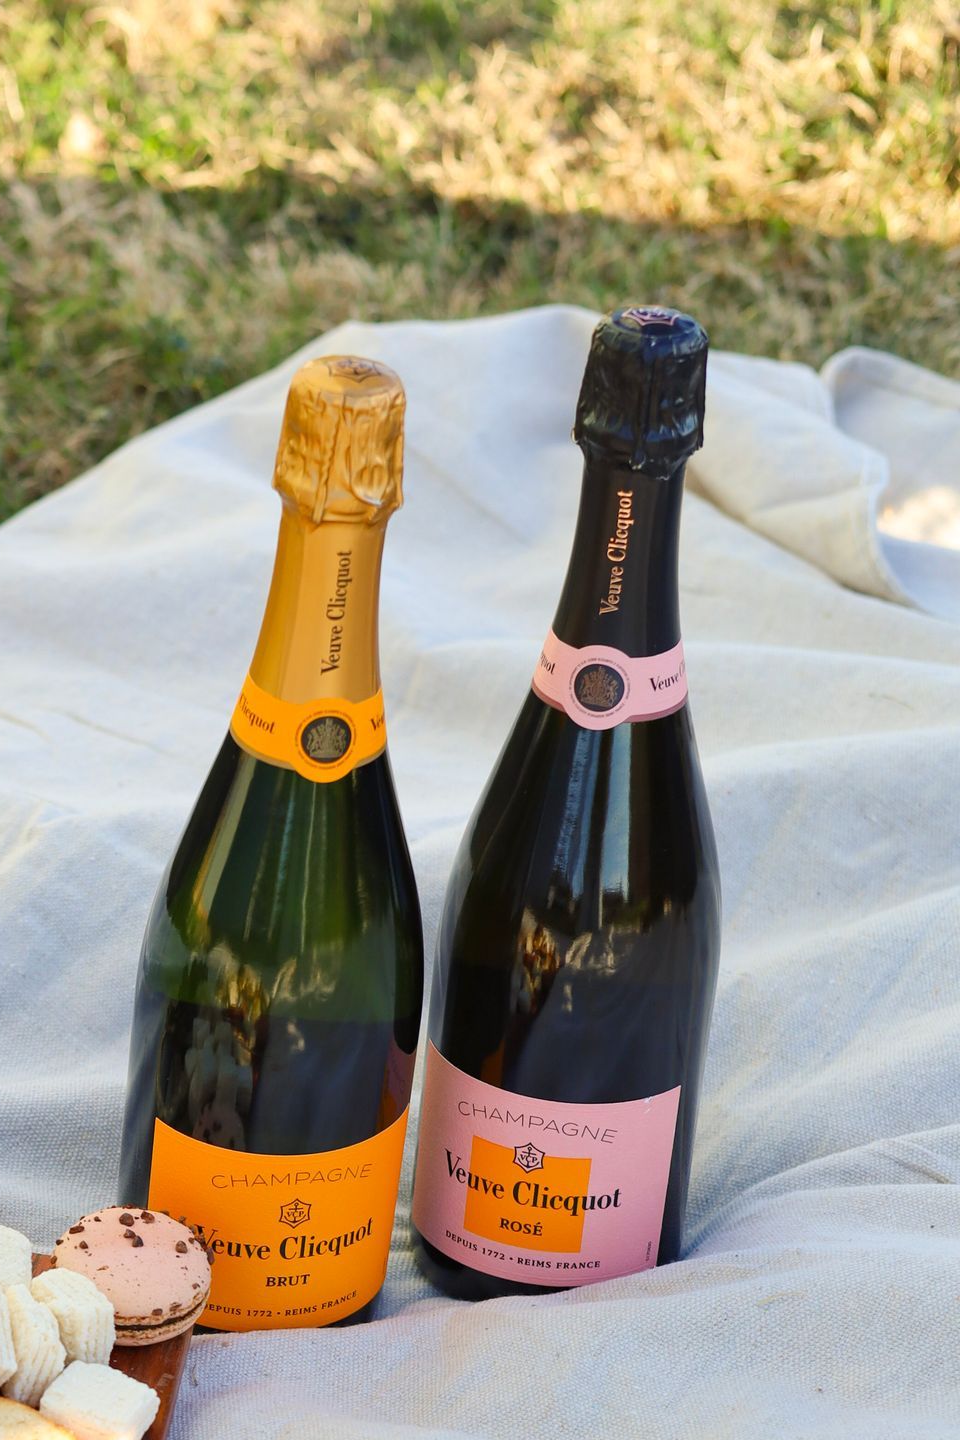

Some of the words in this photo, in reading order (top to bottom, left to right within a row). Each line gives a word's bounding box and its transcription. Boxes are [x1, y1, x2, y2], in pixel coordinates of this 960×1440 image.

[607, 489, 635, 562] Clicquot
[326, 550, 352, 621] Clicquot
[599, 566, 624, 615] Veuve
[320, 625, 343, 675] Veuve
[649, 672, 679, 691] Veuve
[457, 1100, 619, 1144] CHAMPAGNE
[211, 1163, 374, 1189] CHAMPAGNE
[444, 1148, 505, 1199] Veuve
[512, 1180, 622, 1216] Clicquot
[279, 1217, 374, 1260] Clicquot
[499, 1218, 543, 1236] ROSÉ
[445, 1230, 479, 1251] DEPUIS
[481, 1247, 506, 1261] 1772
[517, 1257, 552, 1269] REIMS
[556, 1260, 601, 1270] FRANCE
[265, 1274, 310, 1287] BRUT
[246, 1309, 272, 1318] 1772
[285, 1305, 318, 1316] REIMS
[321, 1290, 358, 1310] FRANCE
